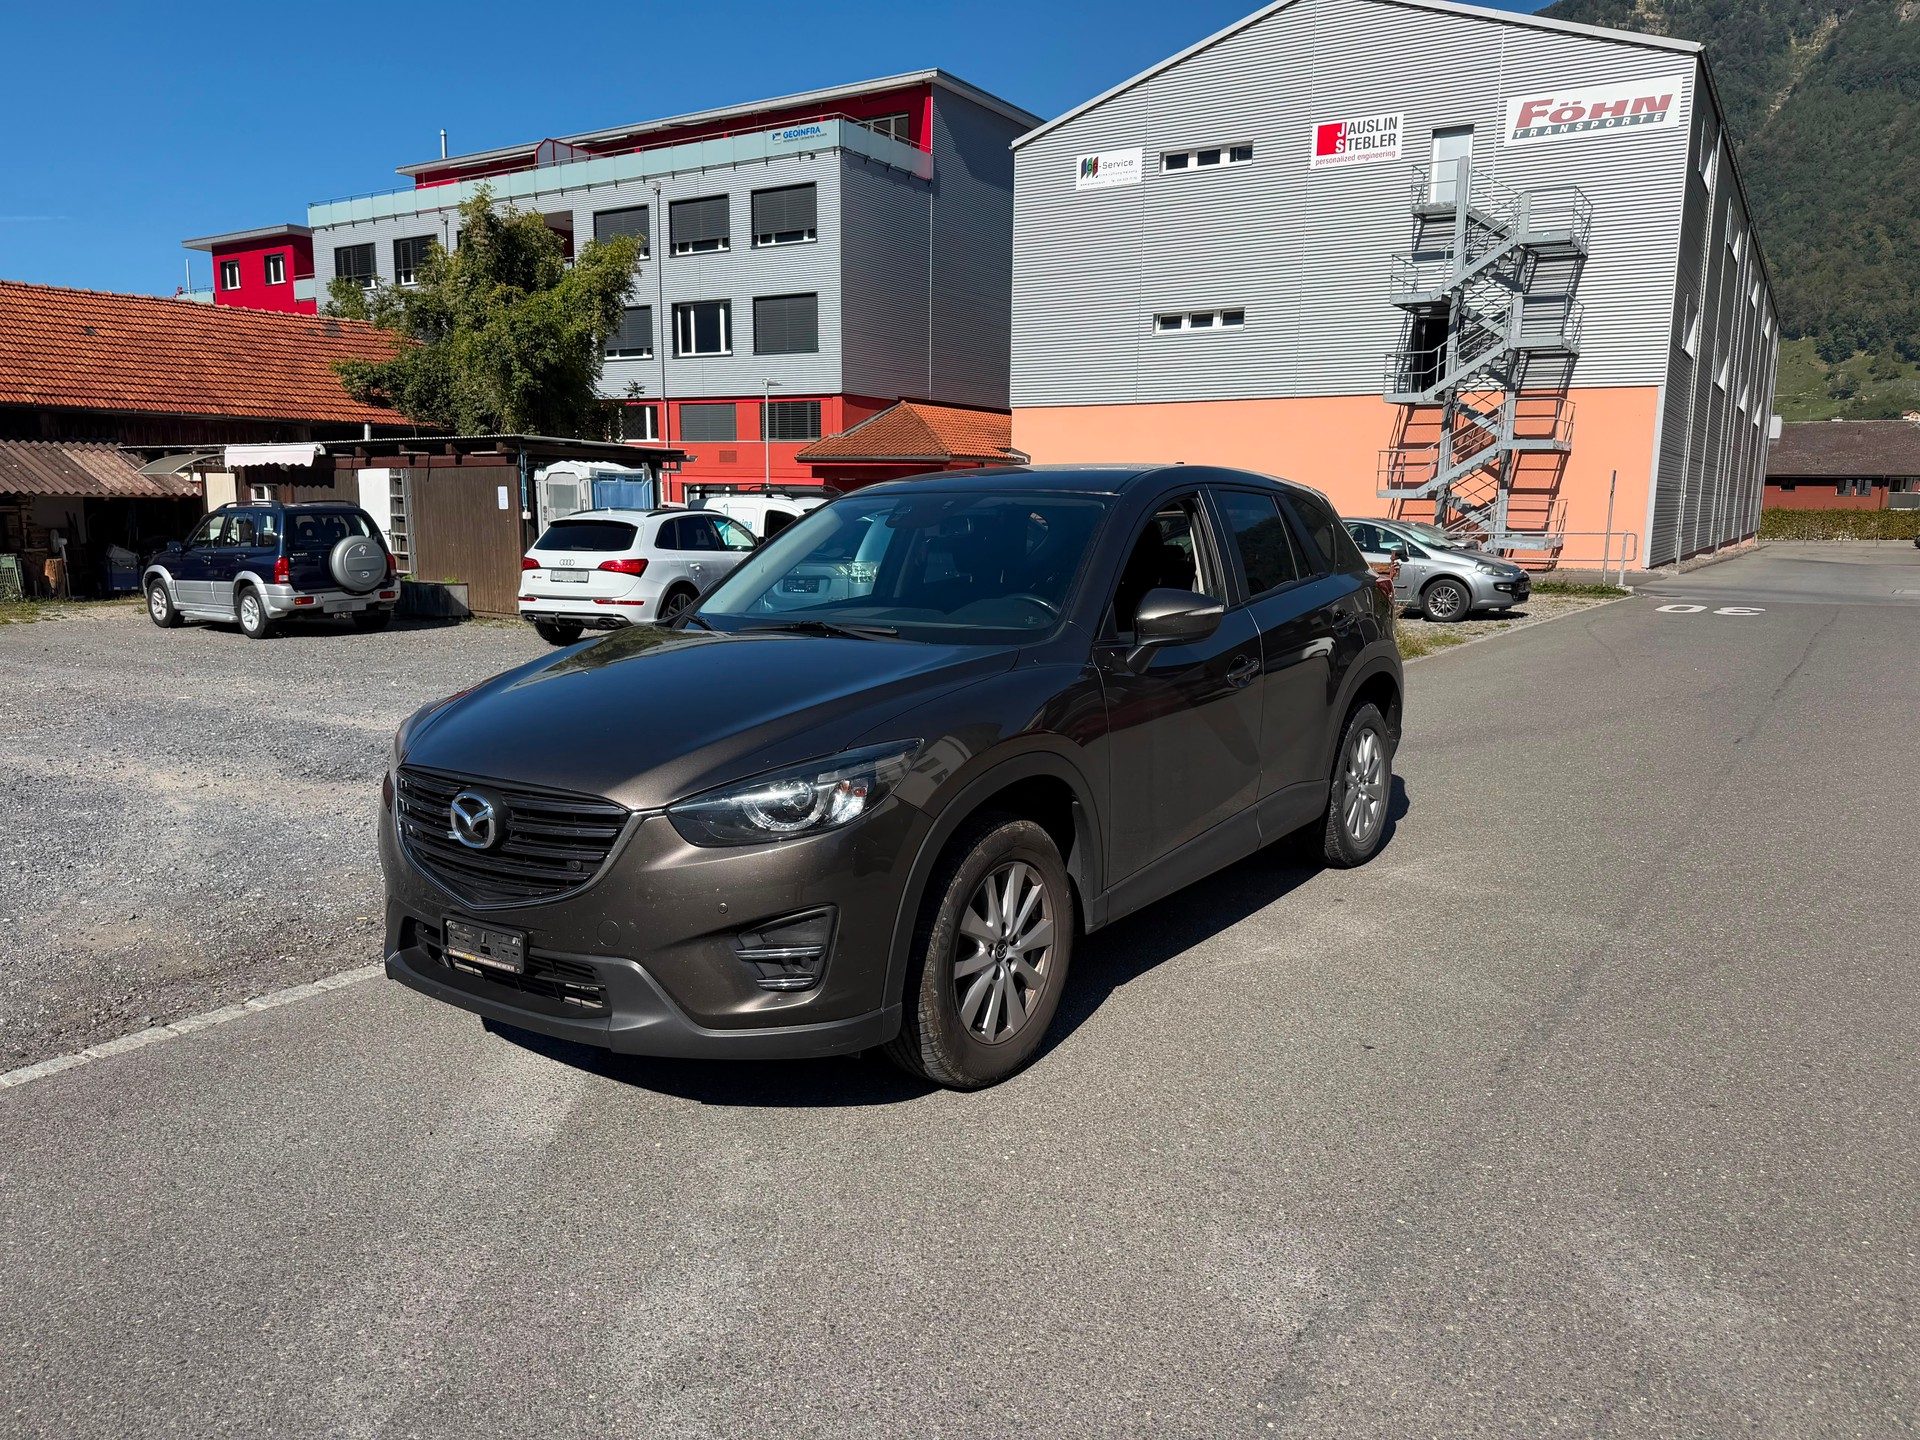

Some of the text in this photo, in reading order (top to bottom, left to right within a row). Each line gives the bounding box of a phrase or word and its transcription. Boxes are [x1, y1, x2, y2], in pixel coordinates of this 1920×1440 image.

[1515, 94, 1673, 128] FÖHN
[783, 126, 821, 139] GEOINFRA
[1336, 116, 1398, 137] JAUSLIN
[1514, 112, 1664, 138] TRANSPORTE
[1335, 133, 1397, 153] STEBLER
[1315, 150, 1396, 166] personalized engineering
